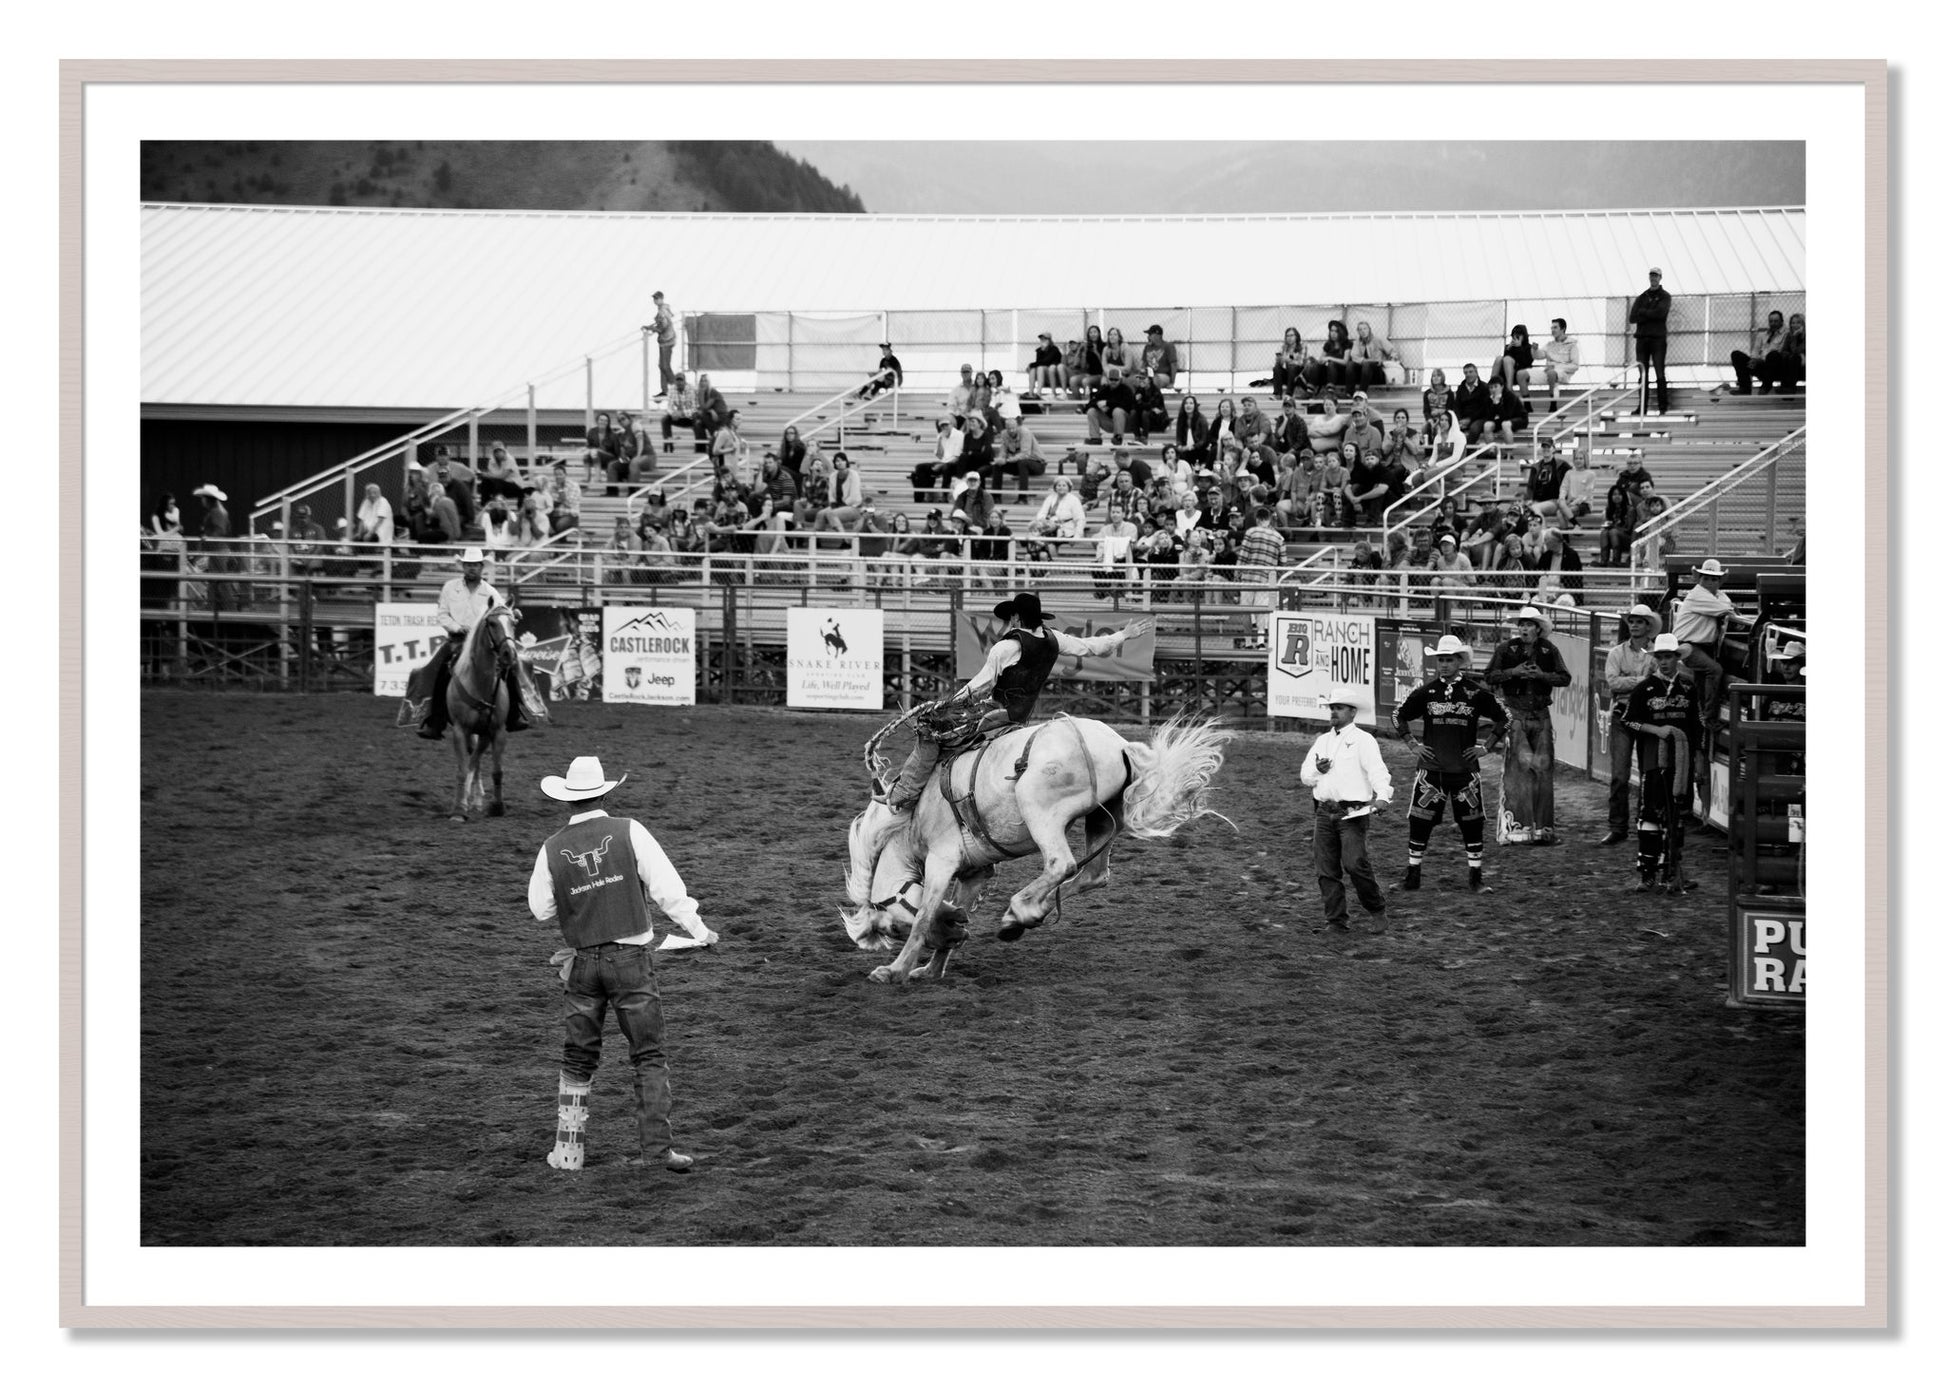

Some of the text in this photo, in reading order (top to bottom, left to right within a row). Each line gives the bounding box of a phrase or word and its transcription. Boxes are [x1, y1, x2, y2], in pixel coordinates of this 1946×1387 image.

[380, 615, 401, 627] TETON
[404, 615, 425, 627] TRASH
[1287, 623, 1308, 634] BIG
[1314, 619, 1370, 645] RANCH
[610, 636, 690, 654] CASTLEROCK
[1281, 634, 1310, 666] R
[789, 659, 880, 670] SNAKE RIVER
[1315, 653, 1330, 667] AND
[1331, 645, 1371, 685] HOME
[647, 673, 675, 687] Jeep
[802, 680, 871, 693] Life, Well Played
[1275, 695, 1290, 706] YOUR
[1291, 696, 1318, 708] PREFERRED
[570, 875, 624, 895] Jackson Hole Rodeo
